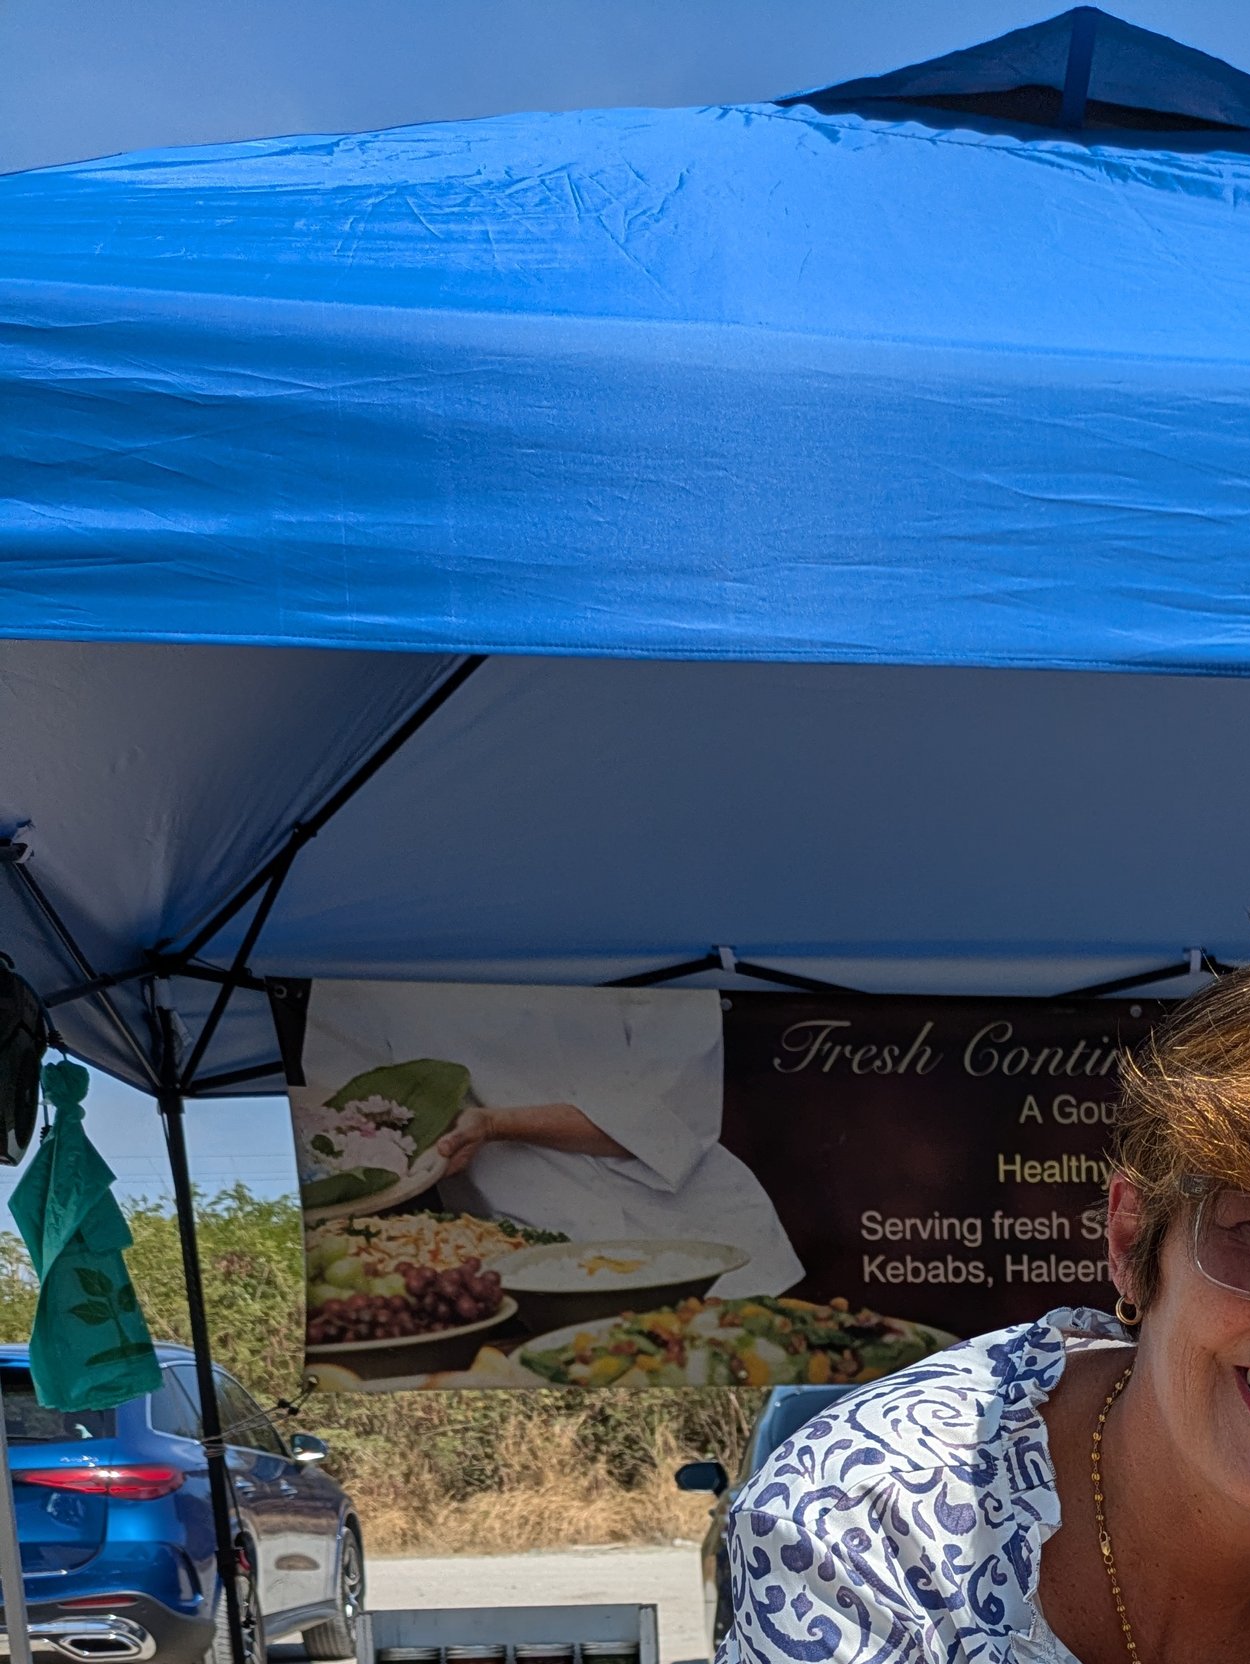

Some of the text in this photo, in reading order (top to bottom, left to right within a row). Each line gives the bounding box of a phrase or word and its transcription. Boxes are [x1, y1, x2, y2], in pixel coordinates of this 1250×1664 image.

[772, 1019, 944, 1075] Fresh
[1019, 1094, 1117, 1125] A Gou
[998, 1153, 1112, 1191] Healthy
[860, 1210, 983, 1248] Serving
[993, 1210, 1070, 1241] fresh
[862, 1254, 994, 1288] Kebabs,
